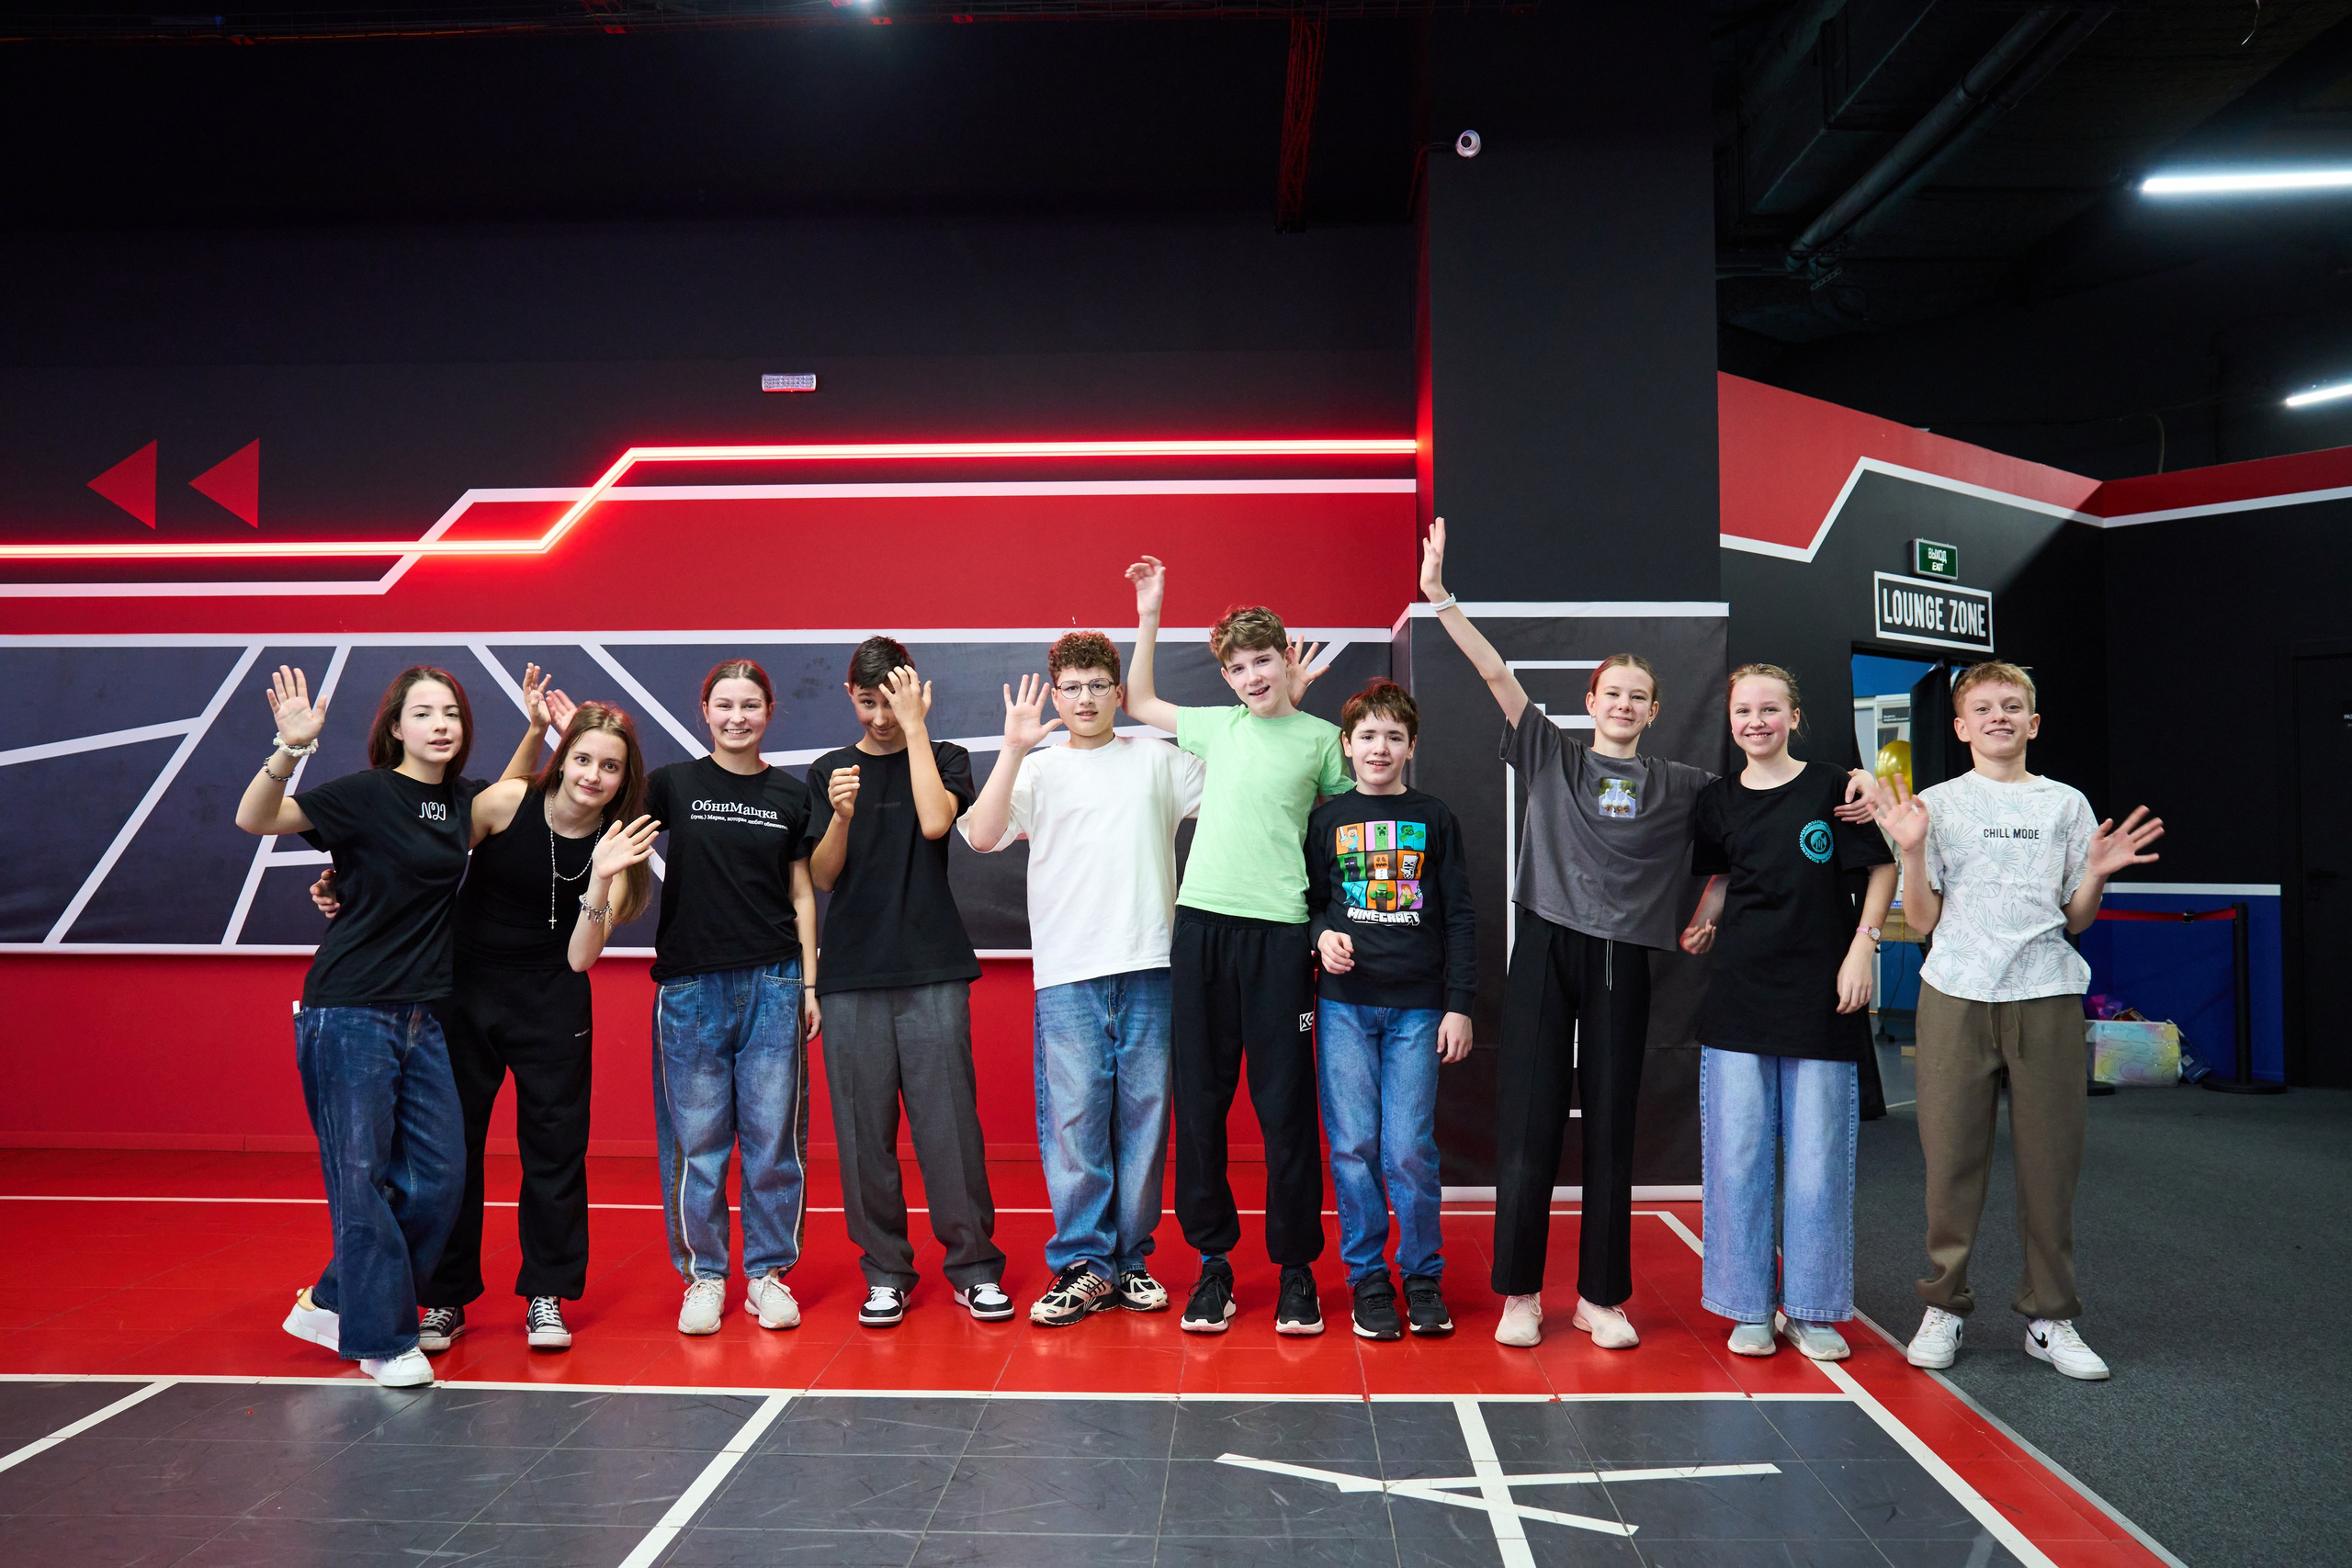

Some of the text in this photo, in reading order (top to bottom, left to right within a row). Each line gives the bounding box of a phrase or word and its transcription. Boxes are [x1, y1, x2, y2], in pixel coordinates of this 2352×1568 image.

[1928, 547, 1947, 564] ВЫХОД
[1932, 562, 1944, 571] EXIT
[1883, 588, 1986, 637] LOUNGE ZONE
[692, 799, 778, 819] ОбниМашка
[1984, 829, 2040, 840] CHILL MODE
[1347, 907, 1420, 927] MINECRAFT
